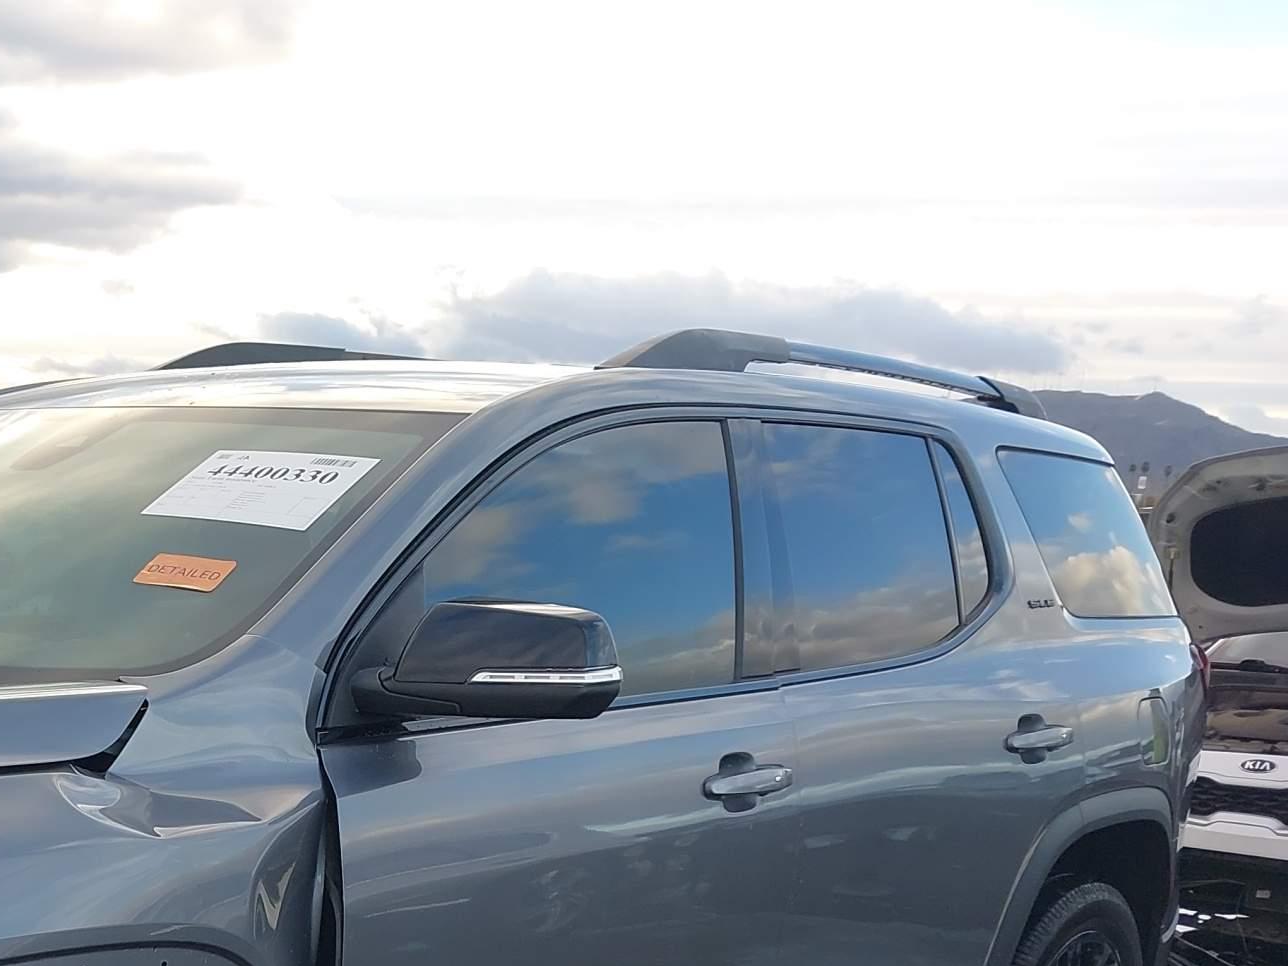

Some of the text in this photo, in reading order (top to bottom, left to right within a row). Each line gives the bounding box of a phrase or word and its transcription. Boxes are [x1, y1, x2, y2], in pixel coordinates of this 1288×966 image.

[207, 463, 340, 485] 44400330
[147, 563, 222, 581] DETAILED
[1244, 760, 1271, 771] KIA
